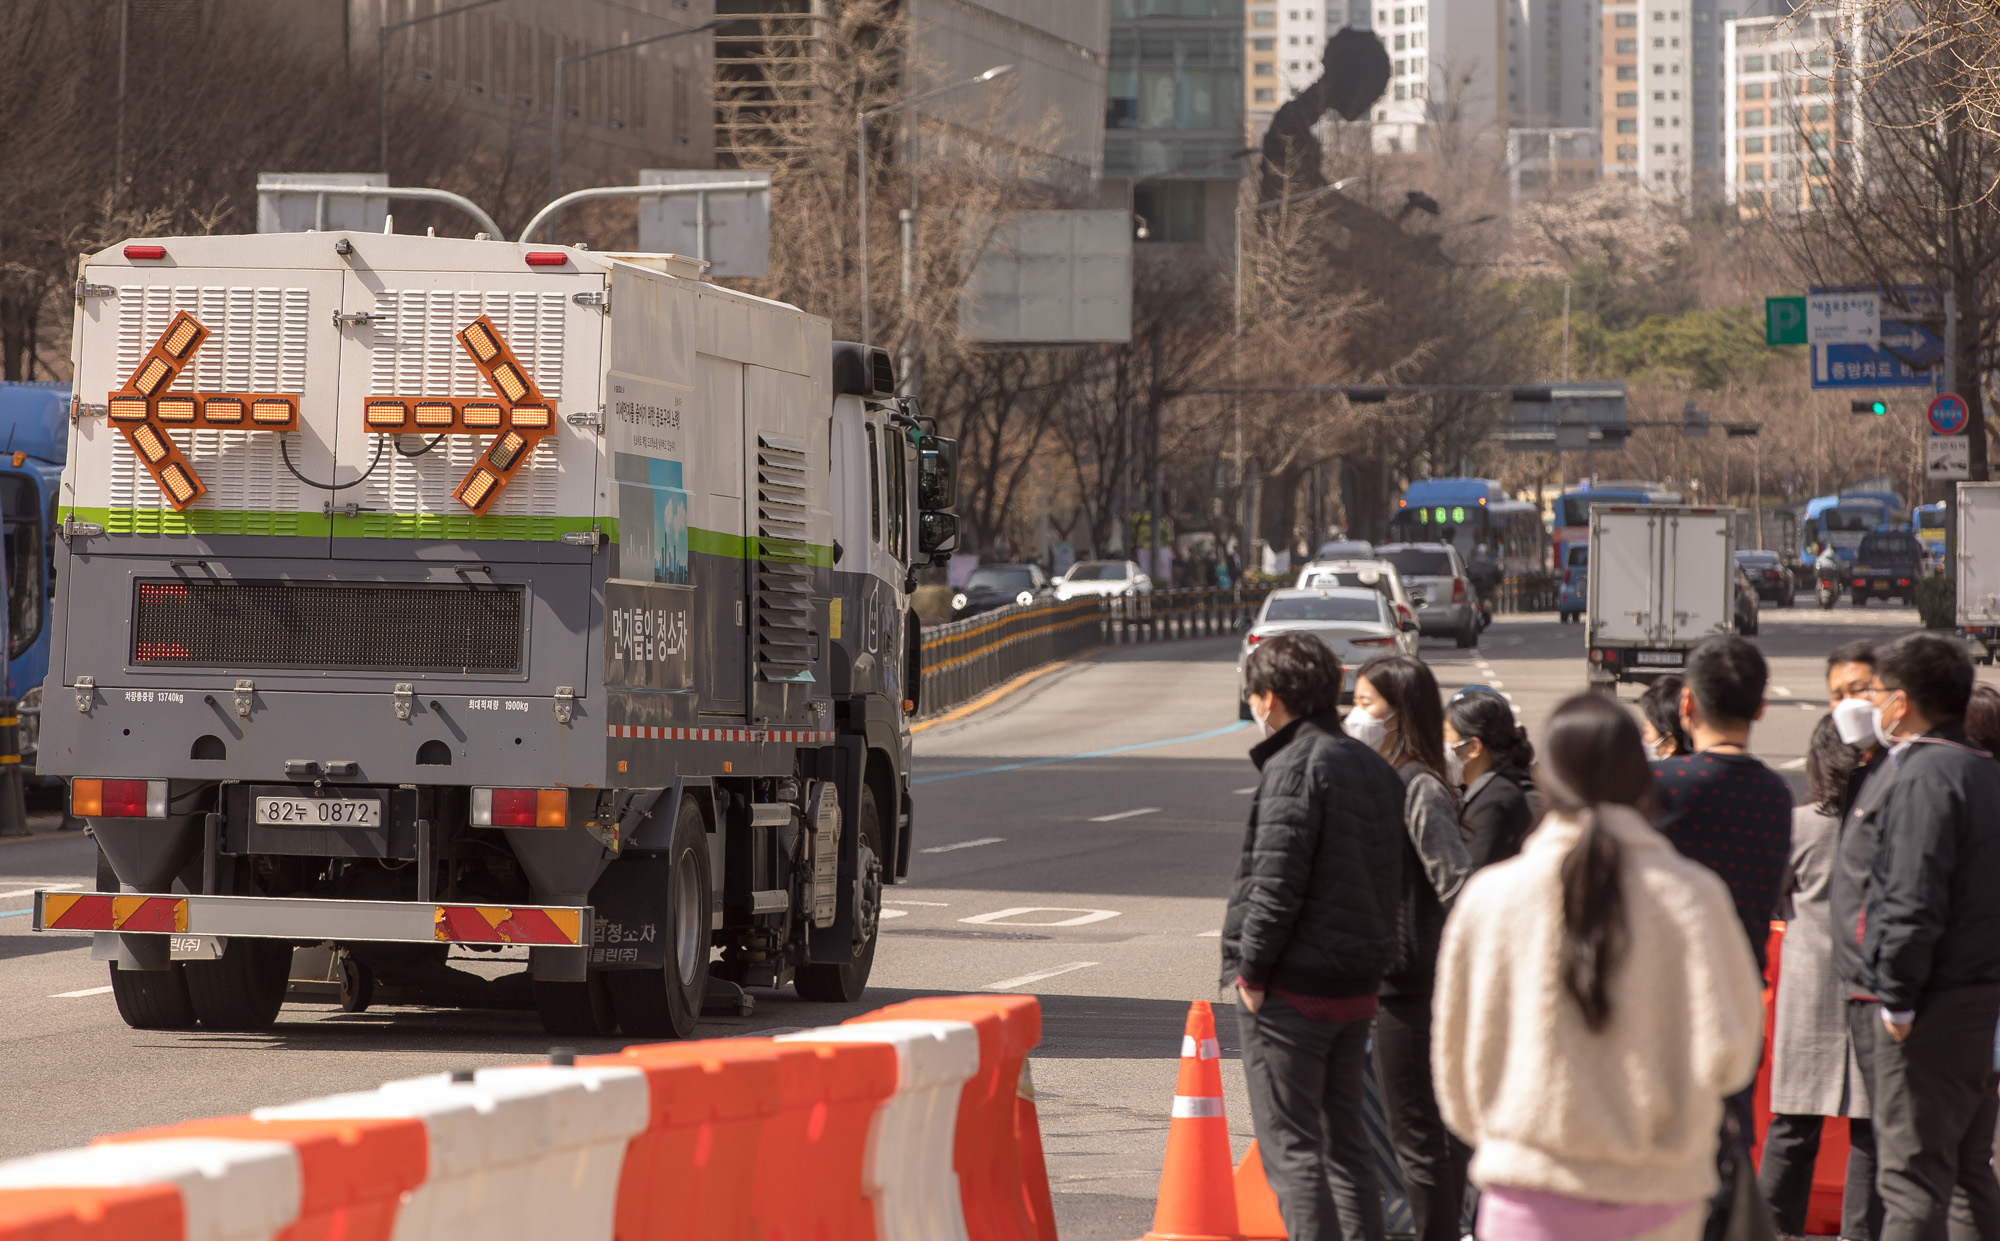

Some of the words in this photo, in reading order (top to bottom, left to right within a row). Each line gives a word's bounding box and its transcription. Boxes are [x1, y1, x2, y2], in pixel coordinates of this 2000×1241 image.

[1770, 302, 1800, 341] P
[612, 607, 653, 661] 먼지흡입
[657, 609, 688, 662] 청소차
[125, 691, 154, 702] 차량총중량
[157, 692, 184, 704] 13740kg
[468, 699, 499, 711] 최대적재량
[505, 701, 529, 713] 1900kg
[268, 801, 307, 821] 82누
[318, 802, 369, 823] 0872
